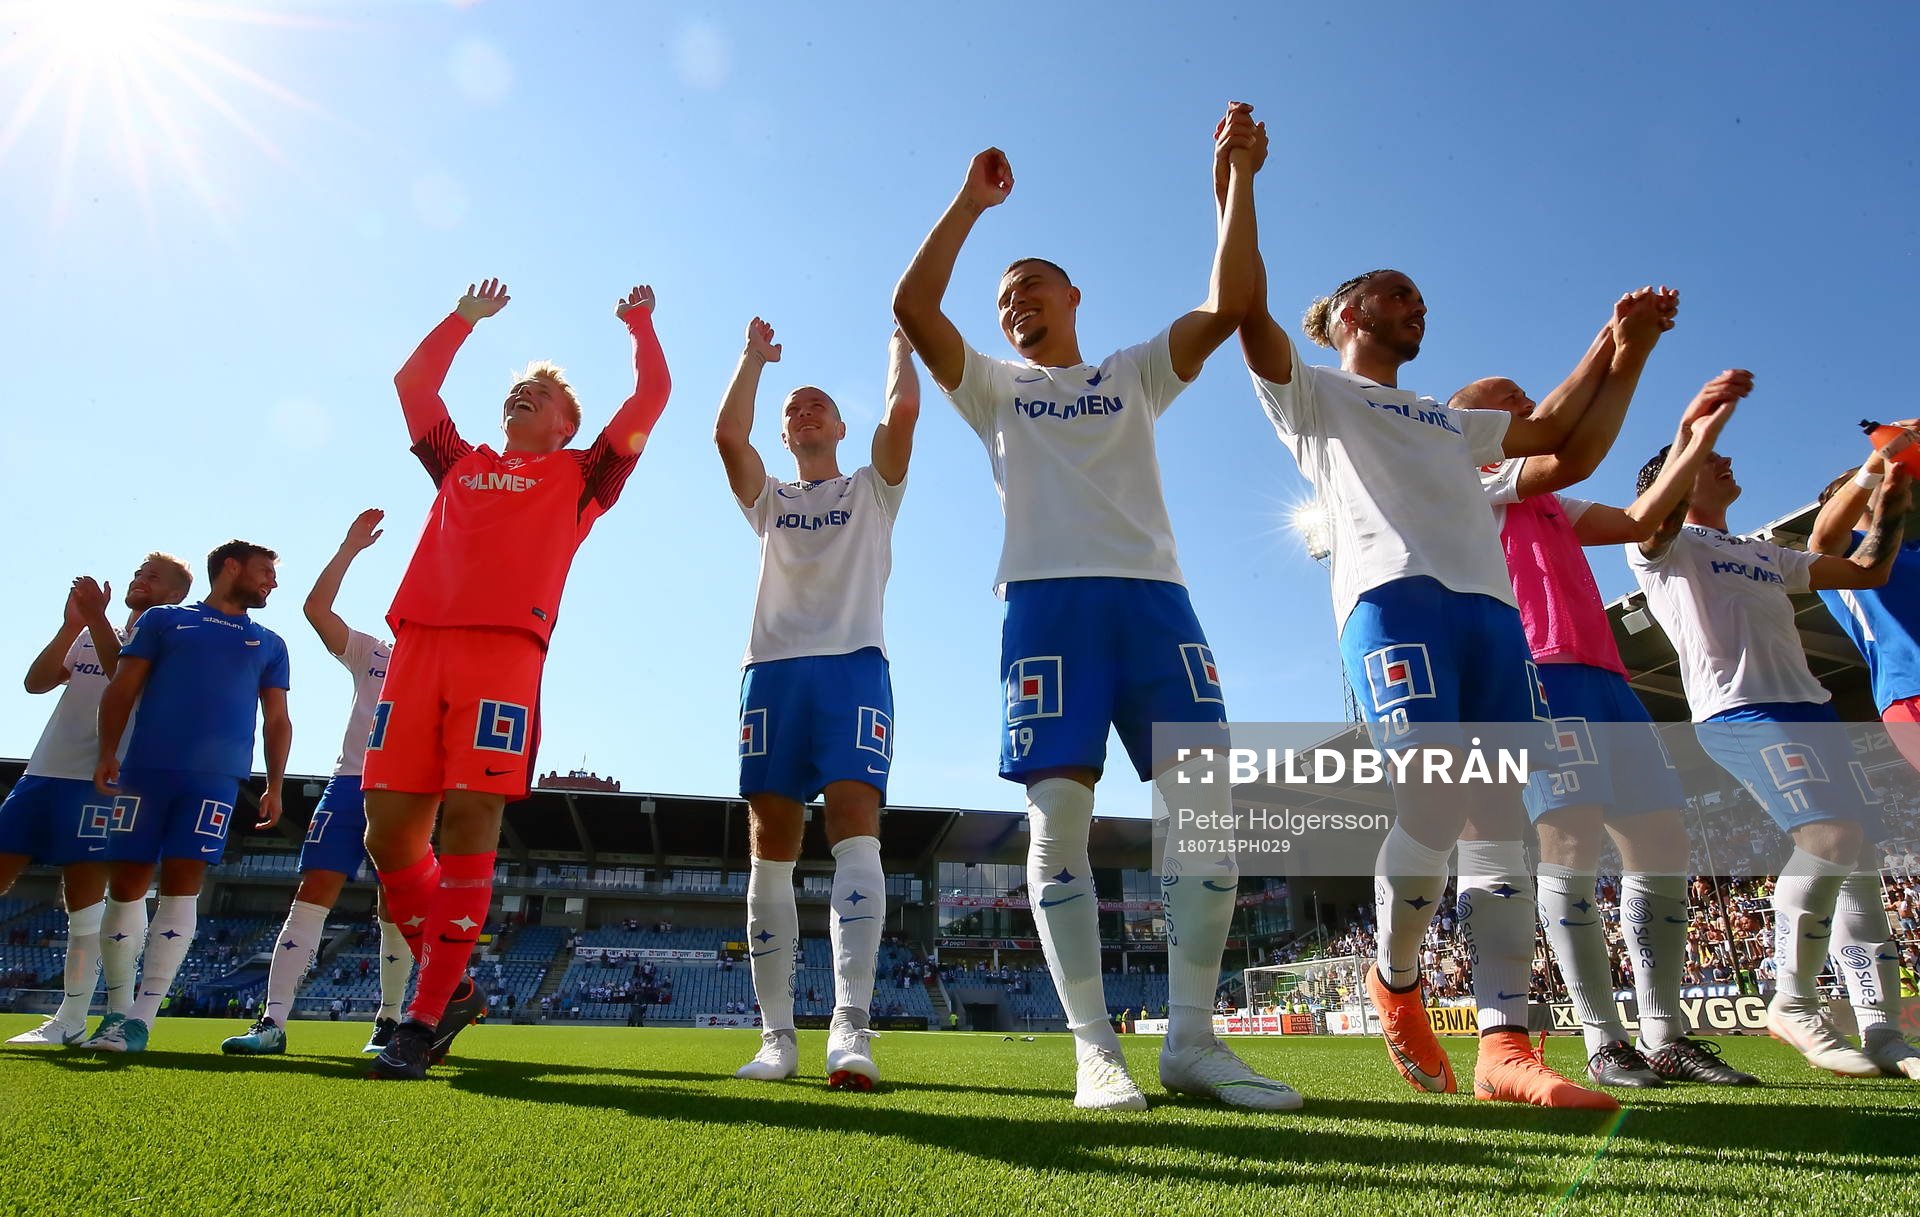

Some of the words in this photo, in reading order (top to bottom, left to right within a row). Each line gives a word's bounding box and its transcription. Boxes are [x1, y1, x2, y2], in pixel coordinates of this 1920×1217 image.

[1014, 394, 1124, 420] HOLMEN
[775, 510, 853, 531] HOLMEN
[202, 616, 244, 631] stadium
[73, 661, 106, 676] HOL
[1008, 727, 1035, 760] 19
[1547, 769, 1581, 796] 20
[1782, 788, 1810, 814] 11
[1632, 926, 1656, 969] suez
[1855, 971, 1878, 1006] suez
